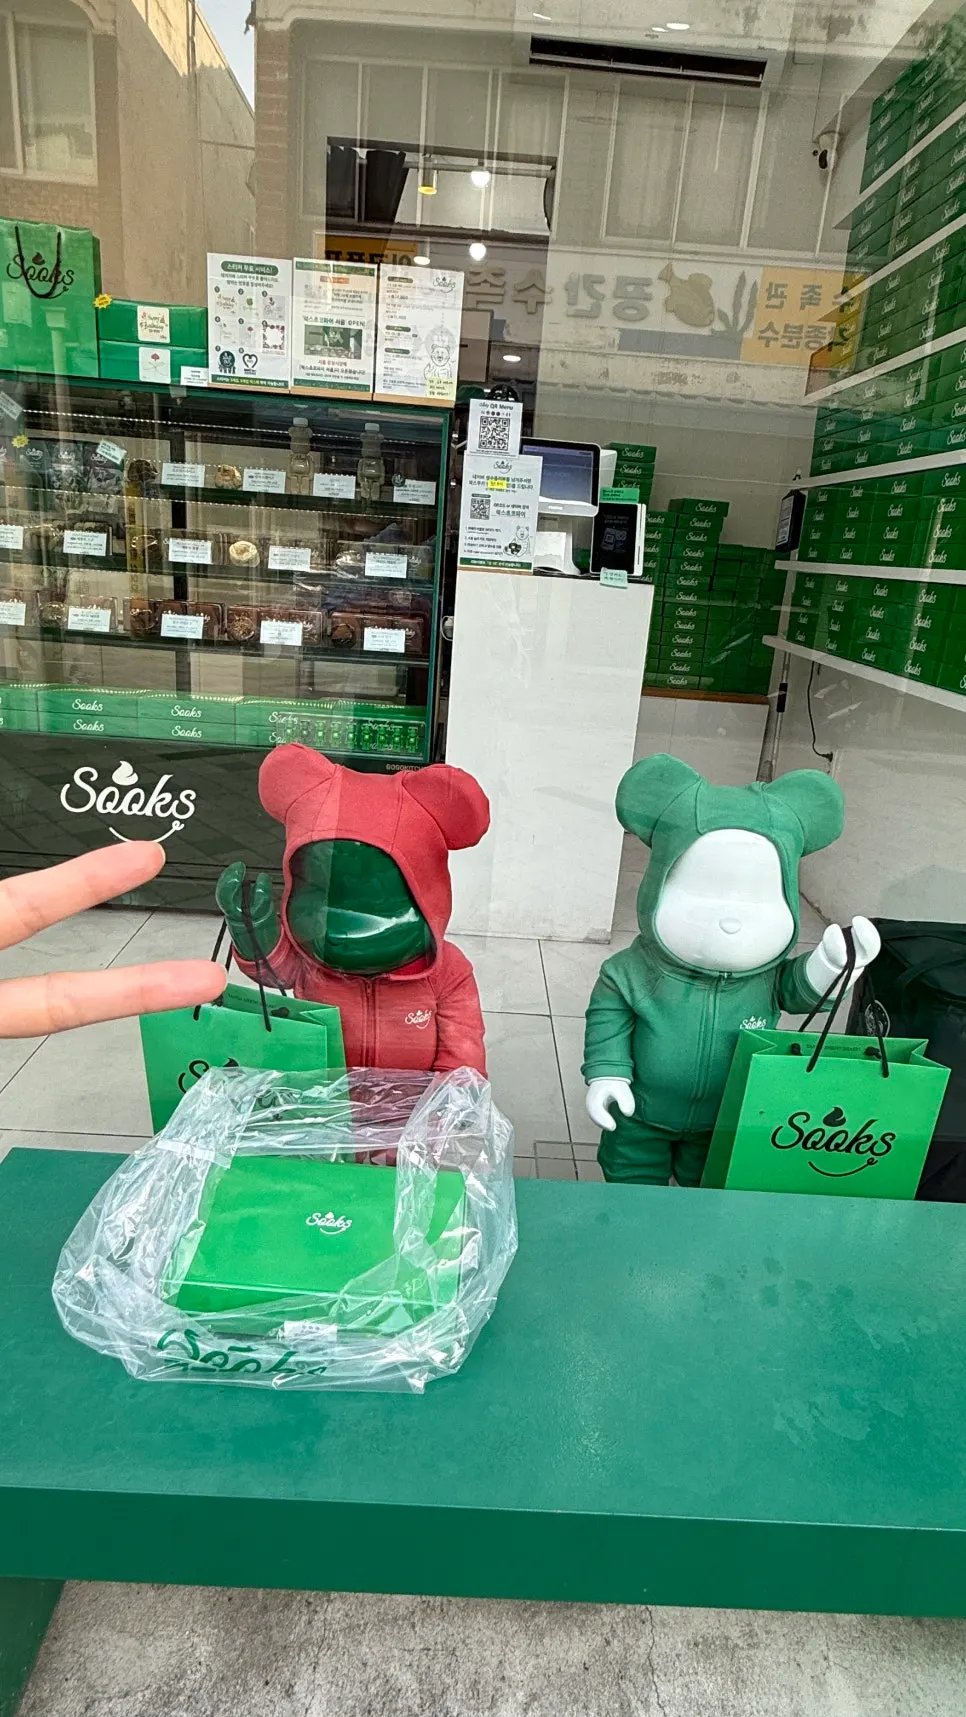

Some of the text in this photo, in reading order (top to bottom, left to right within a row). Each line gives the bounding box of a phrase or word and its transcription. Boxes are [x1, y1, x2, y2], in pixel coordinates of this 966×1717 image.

[6, 254, 74, 285] Sooks
[72, 698, 104, 712] Sooks
[171, 705, 202, 718] Sooks
[74, 720, 104, 732] Sooks
[172, 726, 202, 738] Sooks
[60, 766, 196, 819] Sooks
[405, 1010, 433, 1026] Sooks
[771, 1106, 896, 1157] Sooks
[306, 1212, 352, 1230] Sooks
